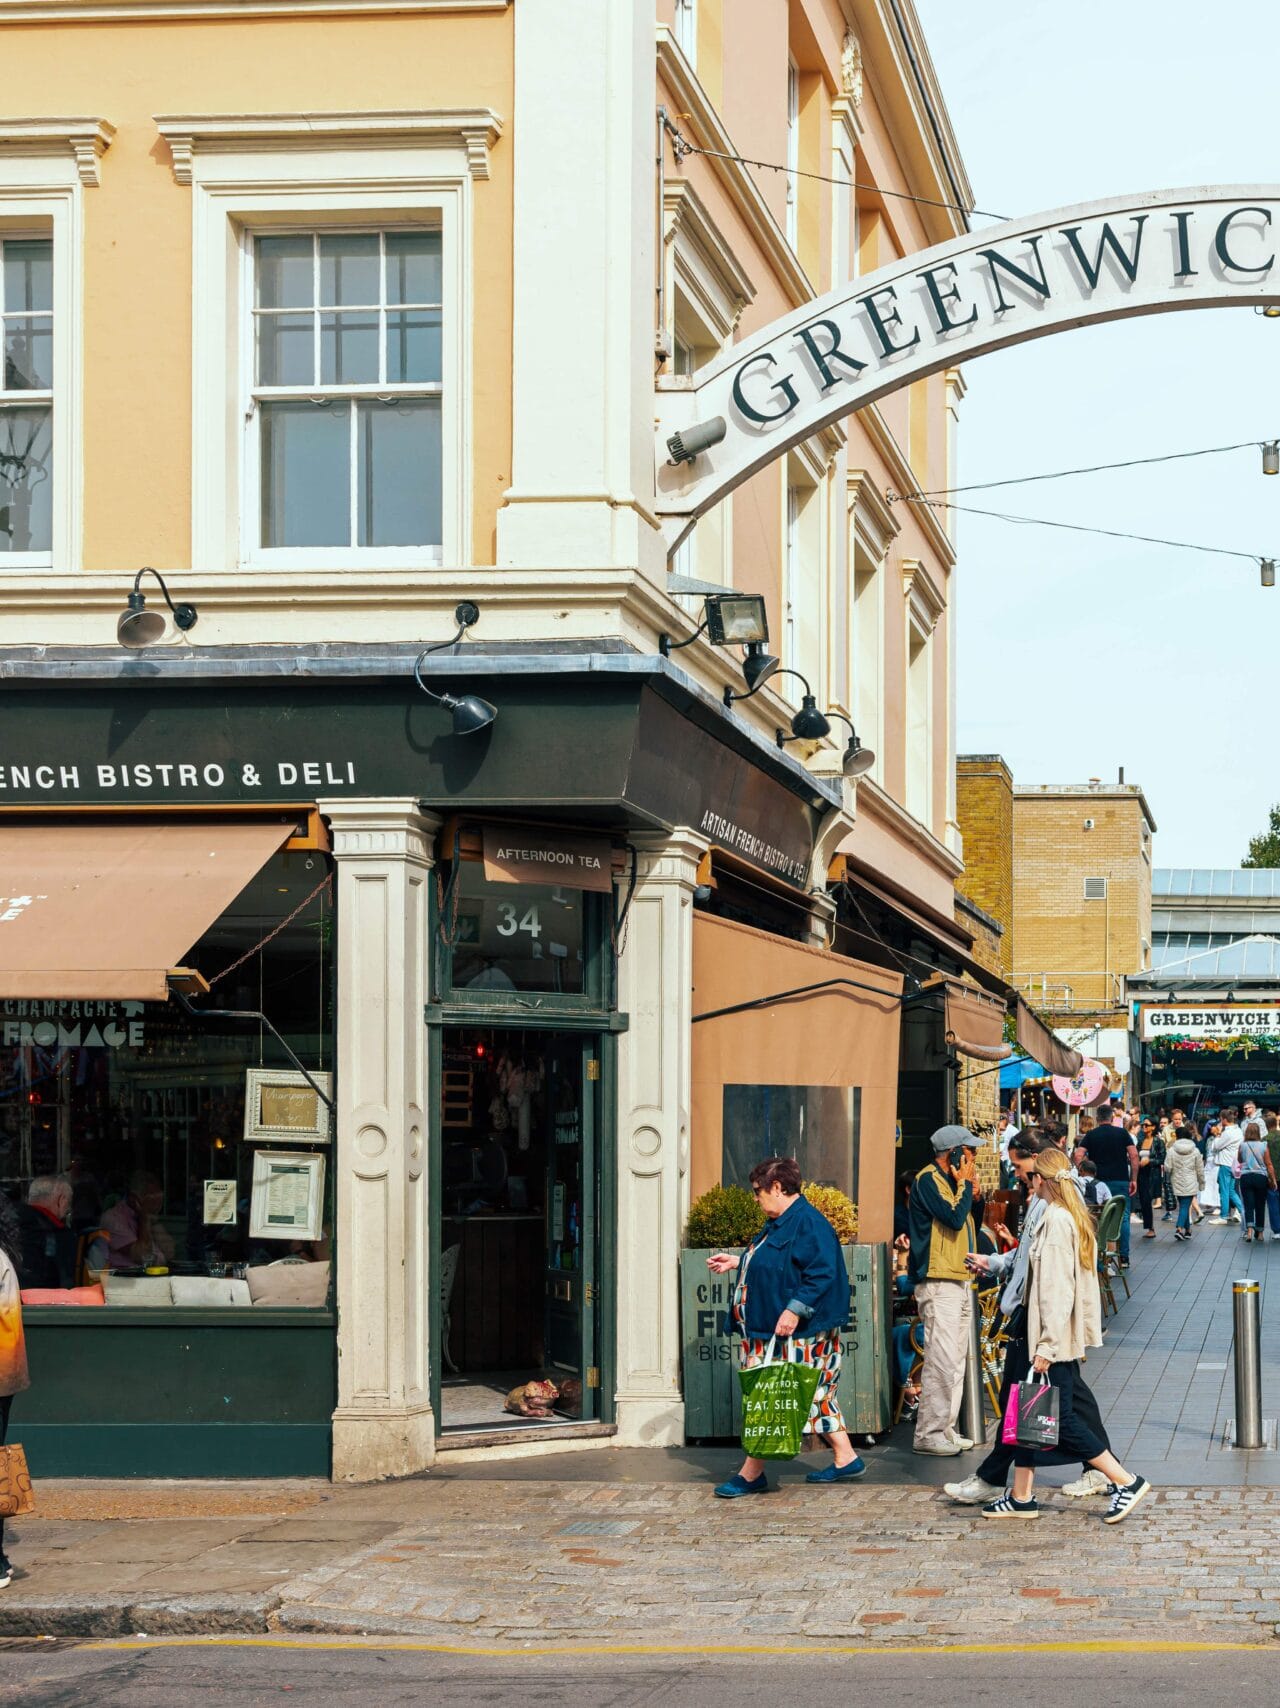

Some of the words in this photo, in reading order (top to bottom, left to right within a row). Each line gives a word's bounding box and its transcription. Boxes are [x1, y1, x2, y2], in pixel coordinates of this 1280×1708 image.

[97, 763, 225, 788] BISTRO
[241, 763, 262, 786] &
[278, 762, 356, 785] DELI
[701, 809, 738, 844] ARTISAN
[735, 828, 766, 859] FRENCH
[763, 845, 789, 873] BISTRO
[787, 859, 794, 877] &
[496, 848, 574, 865] AFTERNOON
[578, 855, 601, 869] TEA
[496, 902, 542, 938] 34
[1151, 1012, 1270, 1026] GREENWICH
[4, 1021, 145, 1047] FROMAGE
[856, 1274, 868, 1282] TM
[746, 1400, 769, 1412] EAT.
[744, 1425, 792, 1438] REPEAT.
